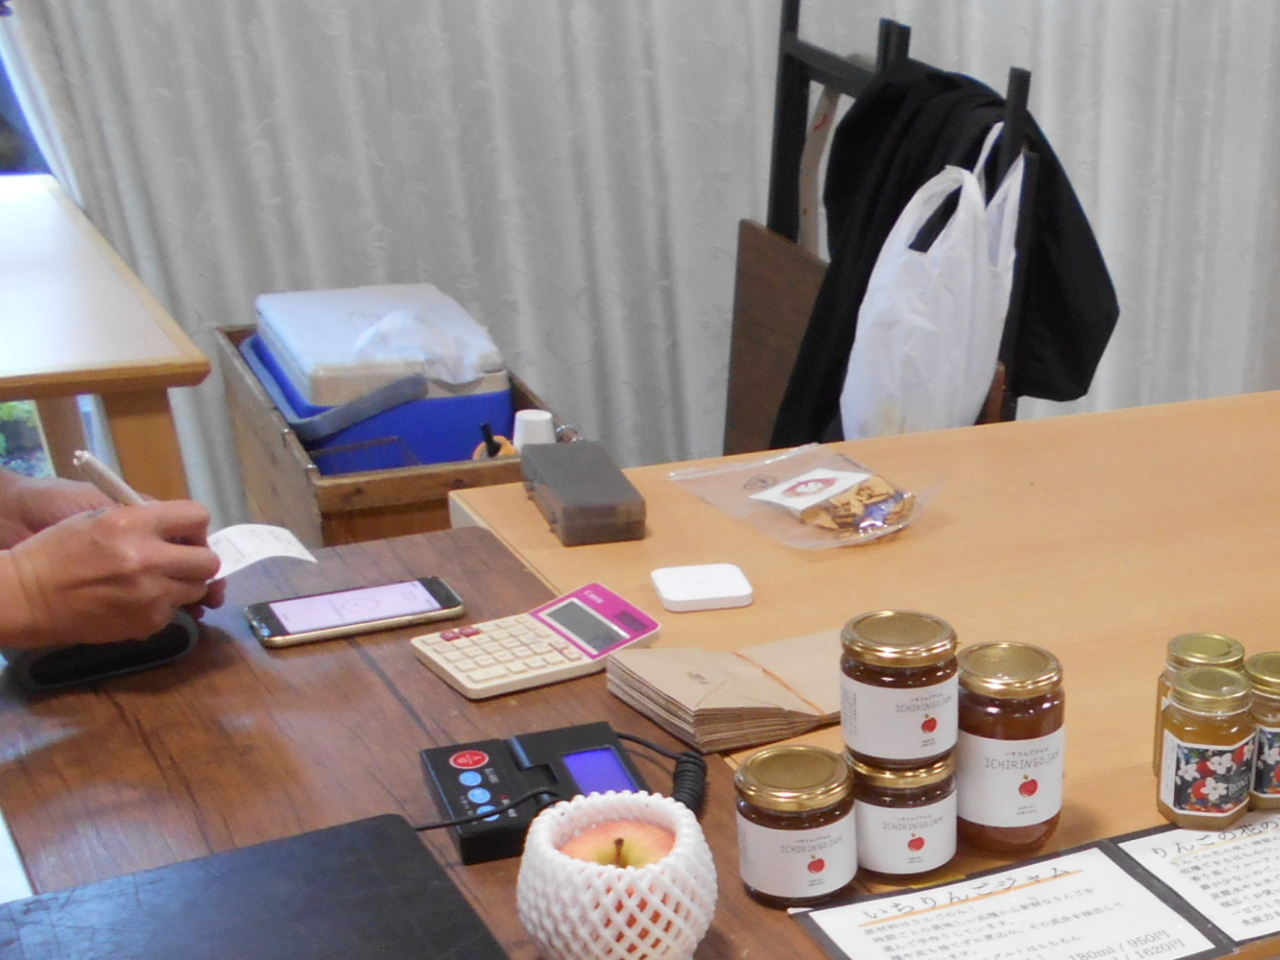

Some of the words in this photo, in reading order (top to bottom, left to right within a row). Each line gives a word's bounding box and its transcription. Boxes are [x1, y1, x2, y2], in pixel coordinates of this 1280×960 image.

[861, 867, 1071, 919] いちりんごジャム
[1126, 929, 1170, 947] 950円
[1134, 938, 1185, 958] 1620円
